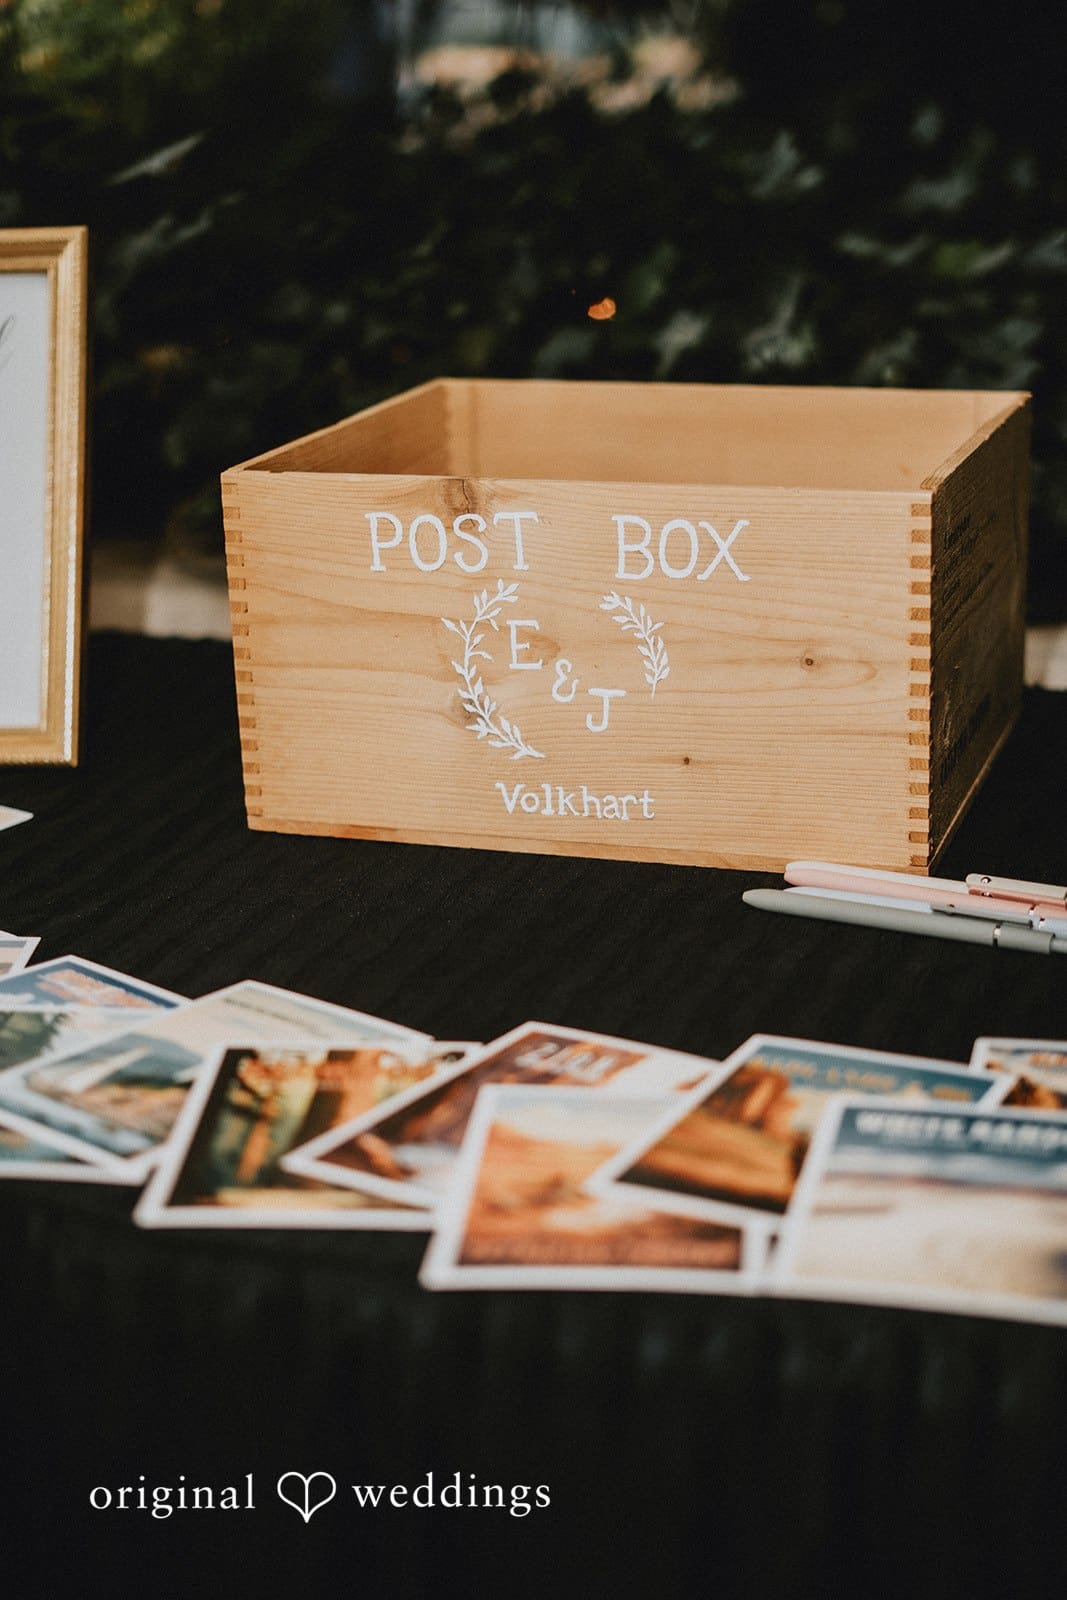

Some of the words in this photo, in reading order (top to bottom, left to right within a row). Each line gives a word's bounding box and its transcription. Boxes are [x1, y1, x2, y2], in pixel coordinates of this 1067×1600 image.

[364, 510, 540, 573] POST
[611, 515, 752, 582] BOX
[506, 619, 543, 670] E
[552, 659, 580, 703] &
[586, 687, 628, 733] J
[495, 782, 656, 821] Volkhart
